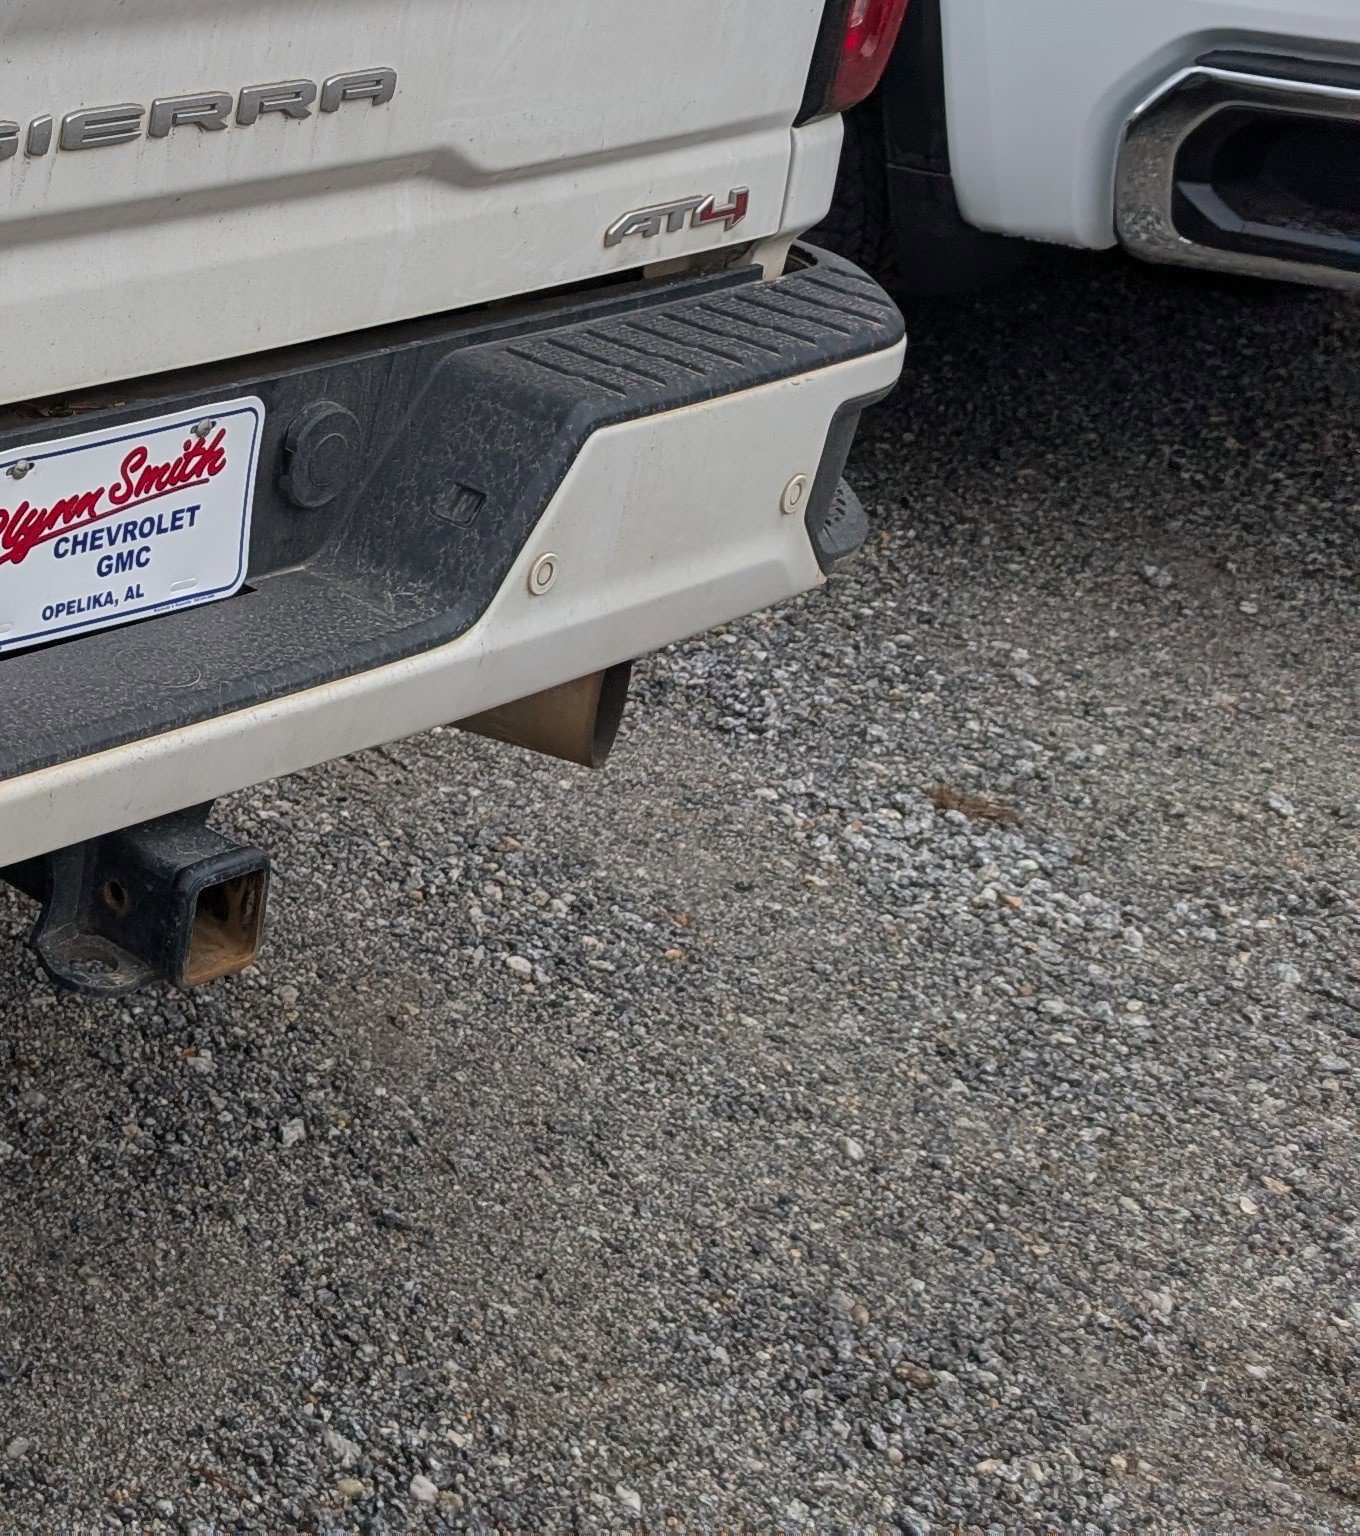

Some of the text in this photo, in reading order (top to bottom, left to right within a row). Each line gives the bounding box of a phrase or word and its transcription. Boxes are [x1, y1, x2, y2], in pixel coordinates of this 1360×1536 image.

[604, 186, 749, 248] AT4
[108, 427, 227, 504] Smith
[53, 504, 201, 560] CHEVROLET
[96, 545, 151, 578] GMC
[41, 590, 119, 622] OPELIKA,
[123, 584, 145, 604] AL
